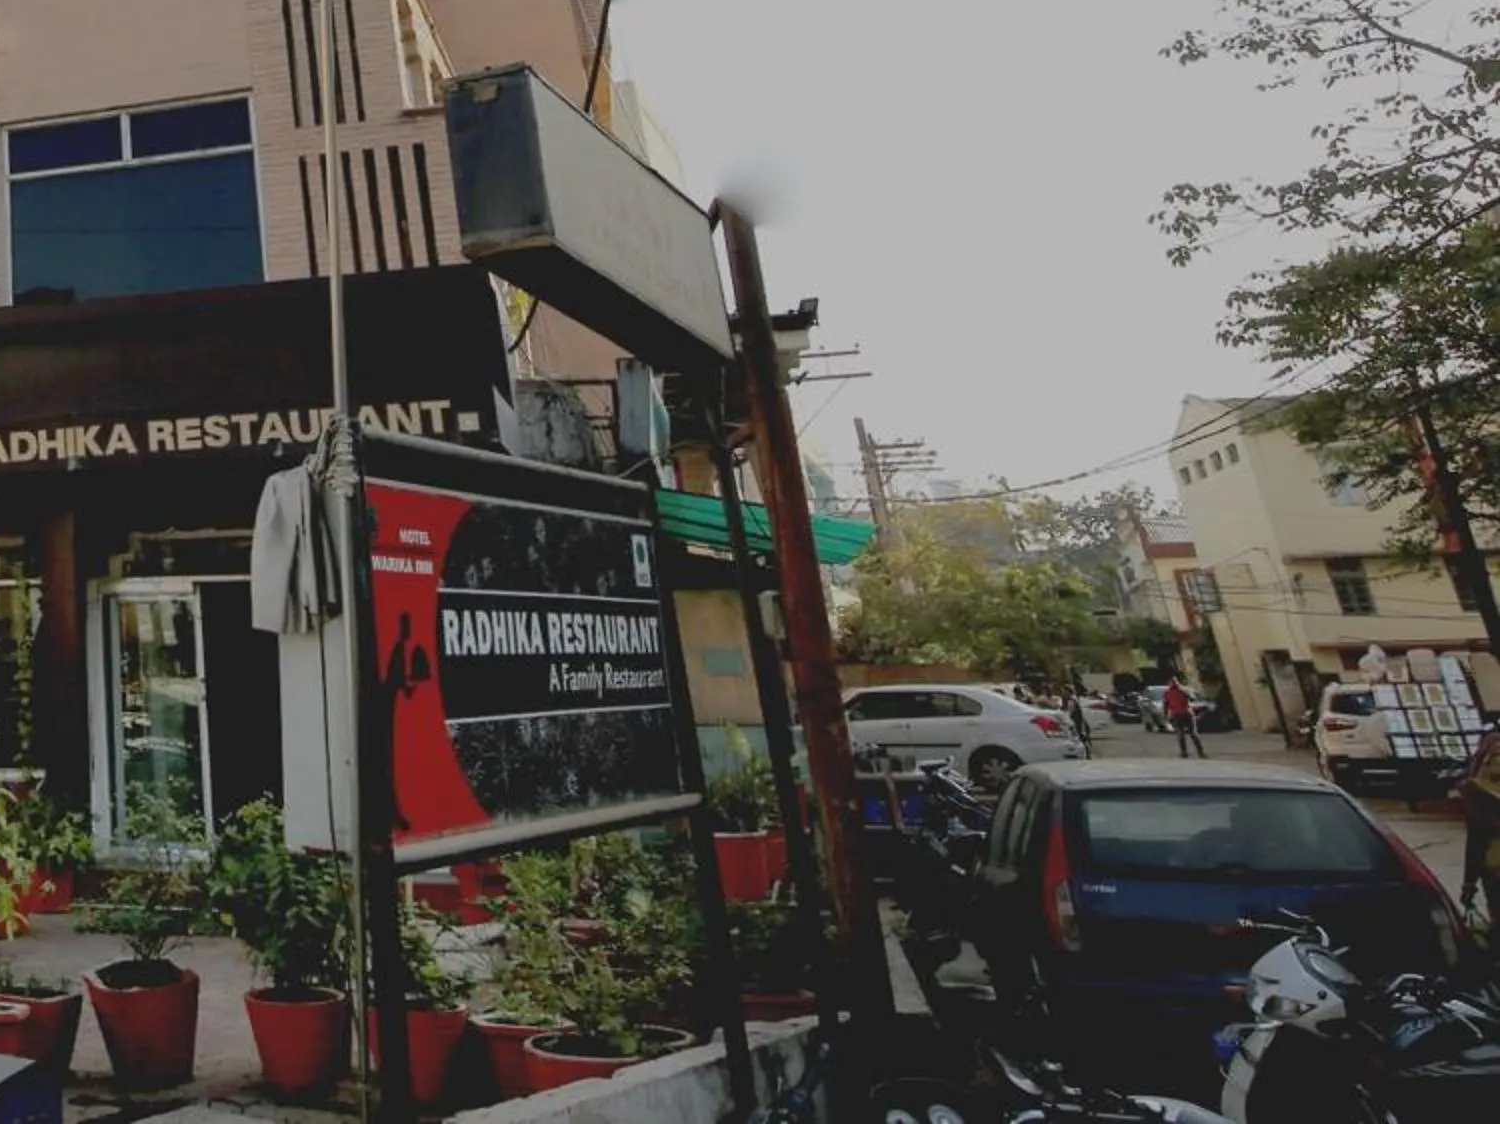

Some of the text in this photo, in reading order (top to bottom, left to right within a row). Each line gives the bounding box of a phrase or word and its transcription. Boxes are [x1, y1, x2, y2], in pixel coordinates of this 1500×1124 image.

[442, 609, 660, 656] RADHIKA RESTAURANT
[549, 661, 666, 699] A Family Restaurant
